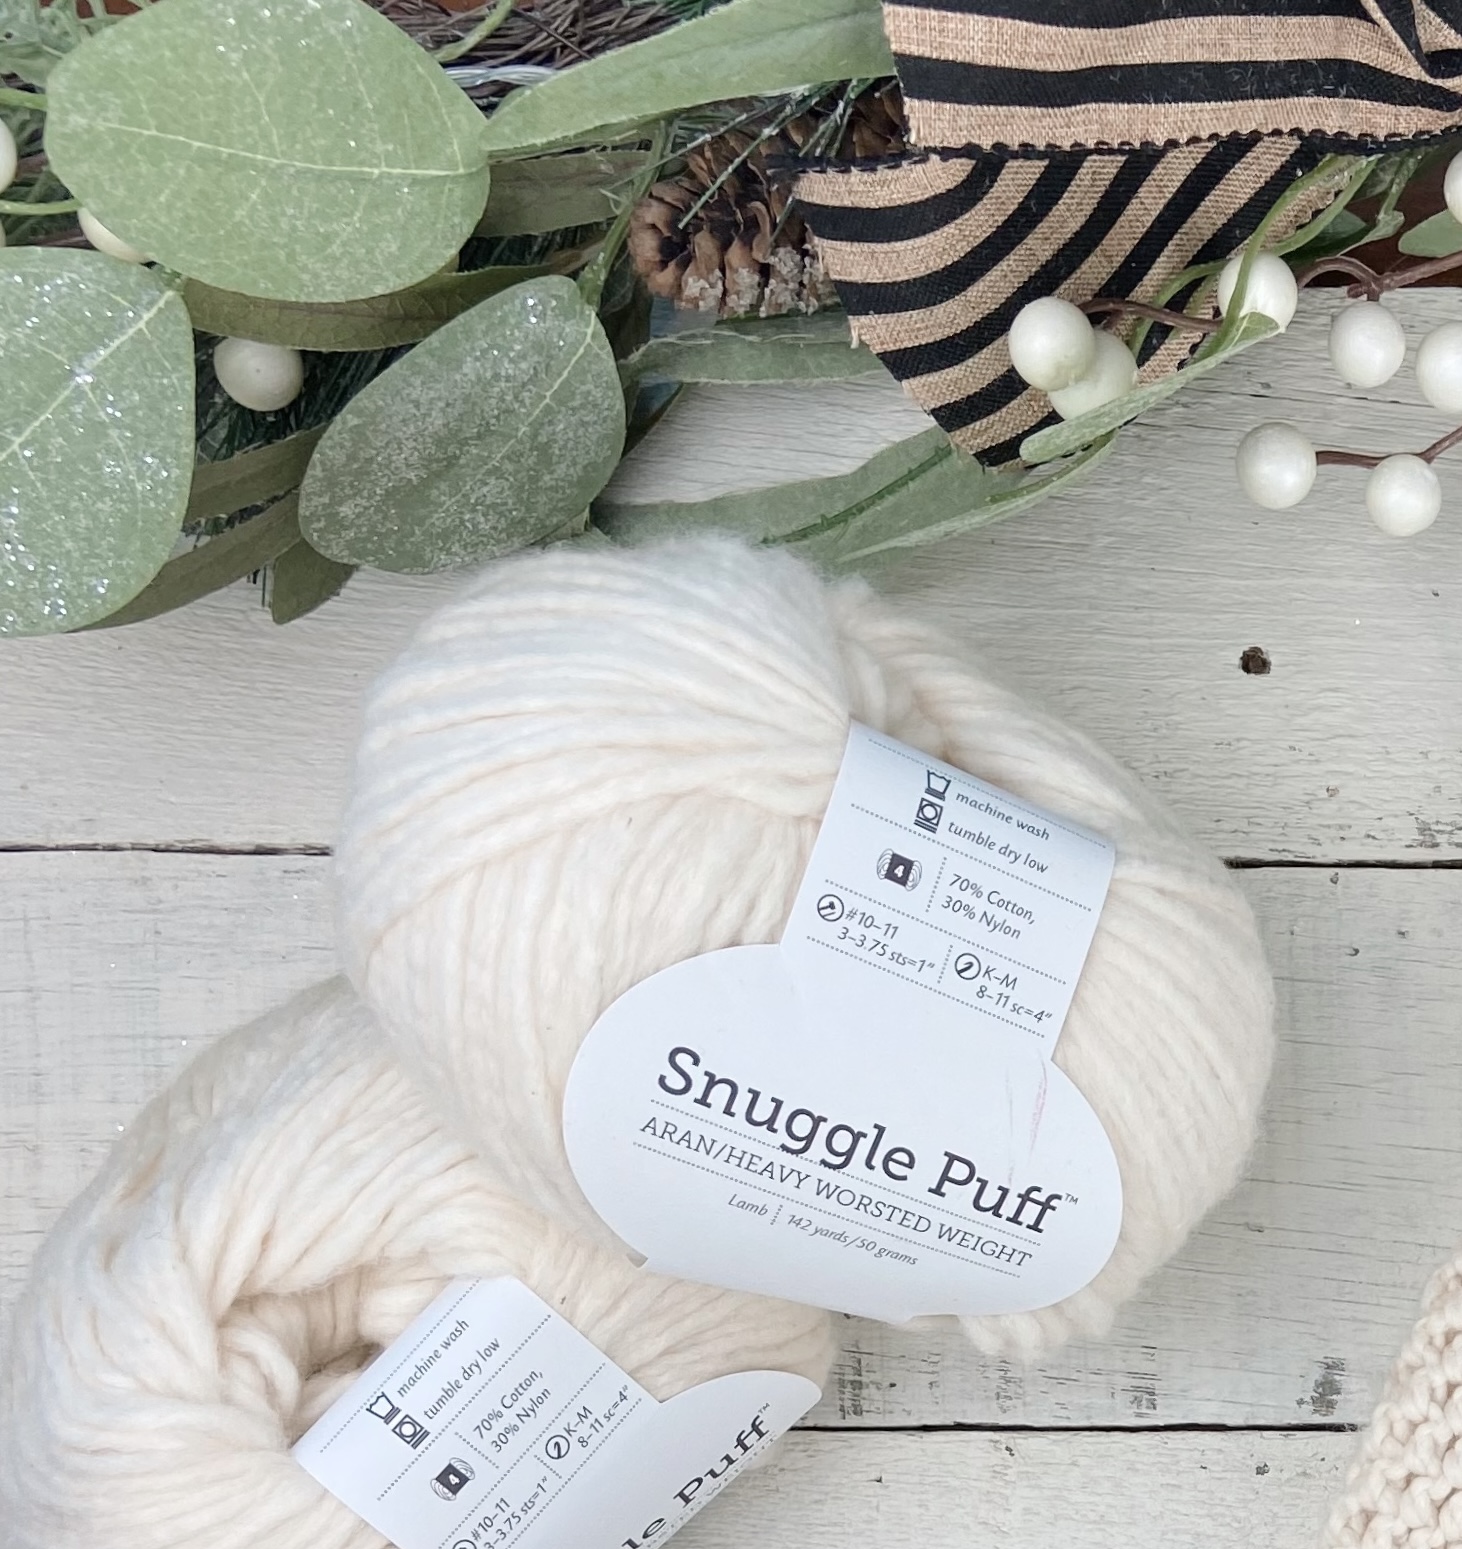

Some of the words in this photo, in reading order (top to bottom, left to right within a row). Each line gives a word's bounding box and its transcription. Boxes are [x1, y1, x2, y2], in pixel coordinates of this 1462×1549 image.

[956, 790, 1013, 825] machine
[1016, 816, 1051, 841] wash
[893, 864, 905, 878] 4
[947, 820, 996, 852] tumble
[998, 842, 1021, 866] dry
[1023, 852, 1048, 874] low
[941, 895, 976, 921] 30%
[979, 911, 1021, 941] Nylon
[948, 873, 983, 900] 70%
[987, 890, 1036, 925] Cotton,
[658, 1045, 916, 1182] Snuggle
[639, 1115, 809, 1190] ARAN/HEAVY
[815, 1177, 932, 1234] WORSTED
[937, 1223, 1034, 1268] WEIGHT
[727, 1192, 768, 1217] Lamb
[787, 1213, 812, 1233] 142
[876, 1247, 918, 1268] grams
[395, 1347, 442, 1398] machine
[439, 1318, 470, 1350] wash
[423, 1376, 463, 1420] tumble
[461, 1356, 482, 1383] dry
[480, 1337, 501, 1362] low
[472, 1406, 504, 1441] 70%
[500, 1371, 545, 1411] Cotton,
[490, 1421, 519, 1453] 30%
[518, 1387, 552, 1425] Nylon
[448, 1473, 461, 1486] 4
